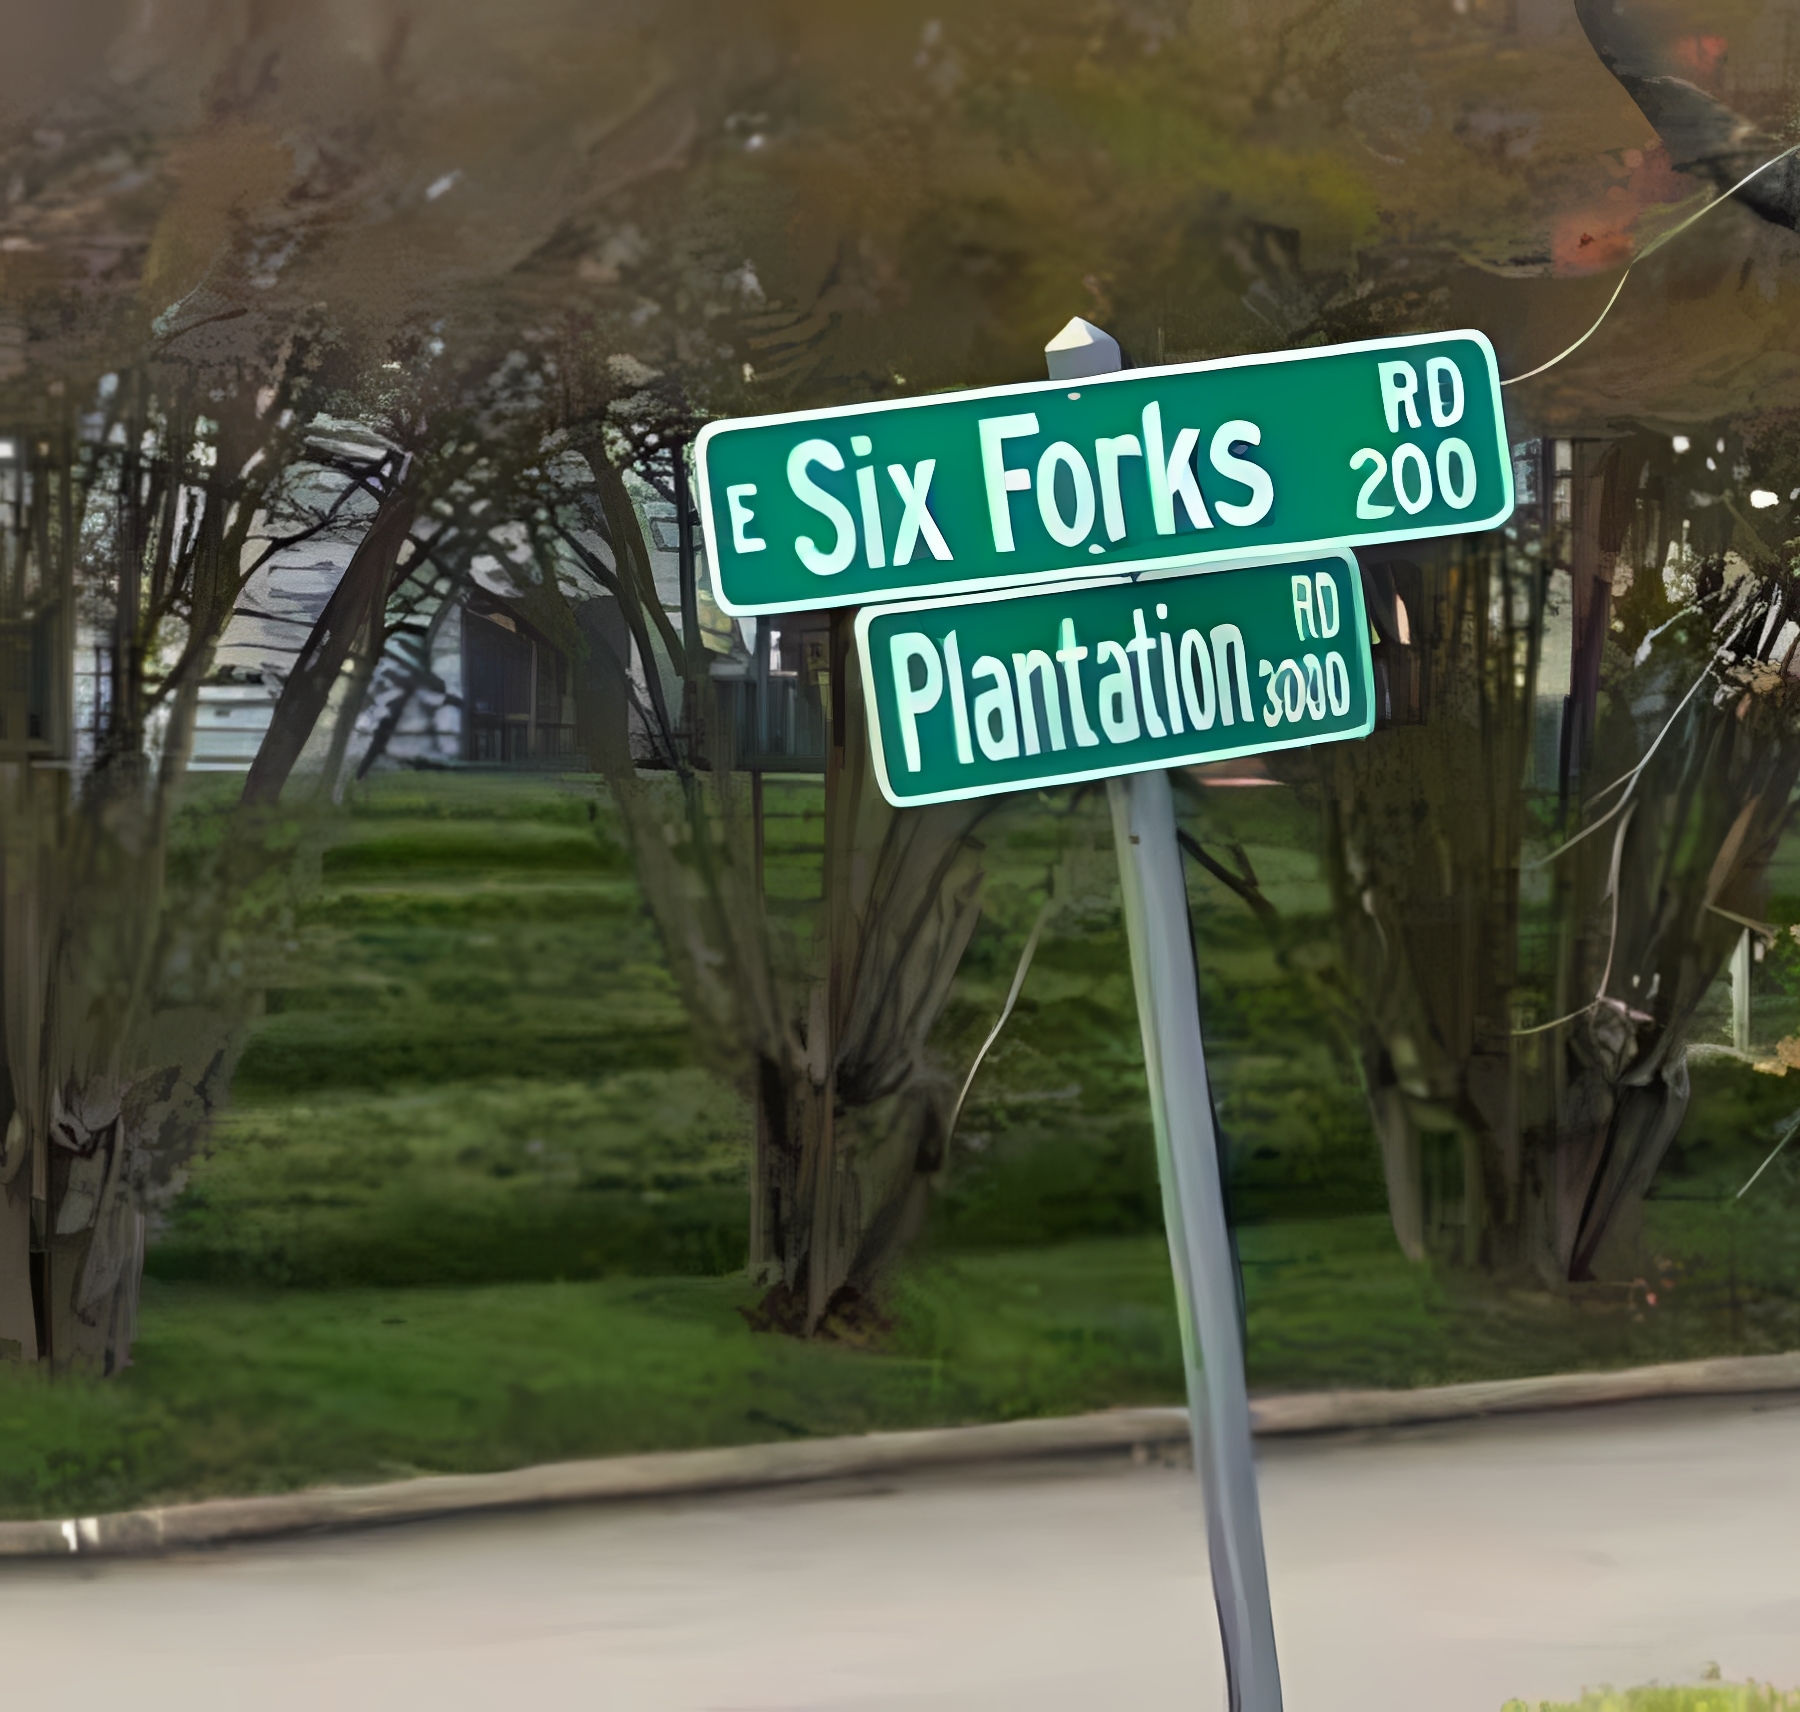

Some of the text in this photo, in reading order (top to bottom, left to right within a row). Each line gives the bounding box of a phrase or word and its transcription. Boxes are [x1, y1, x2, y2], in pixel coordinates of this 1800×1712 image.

[1379, 356, 1466, 433] RD
[726, 402, 1276, 576] E Six Forks
[1349, 437, 1477, 519] 200
[1291, 572, 1340, 641] RD
[889, 604, 1254, 772] Plantation
[1259, 651, 1350, 728] 3000
